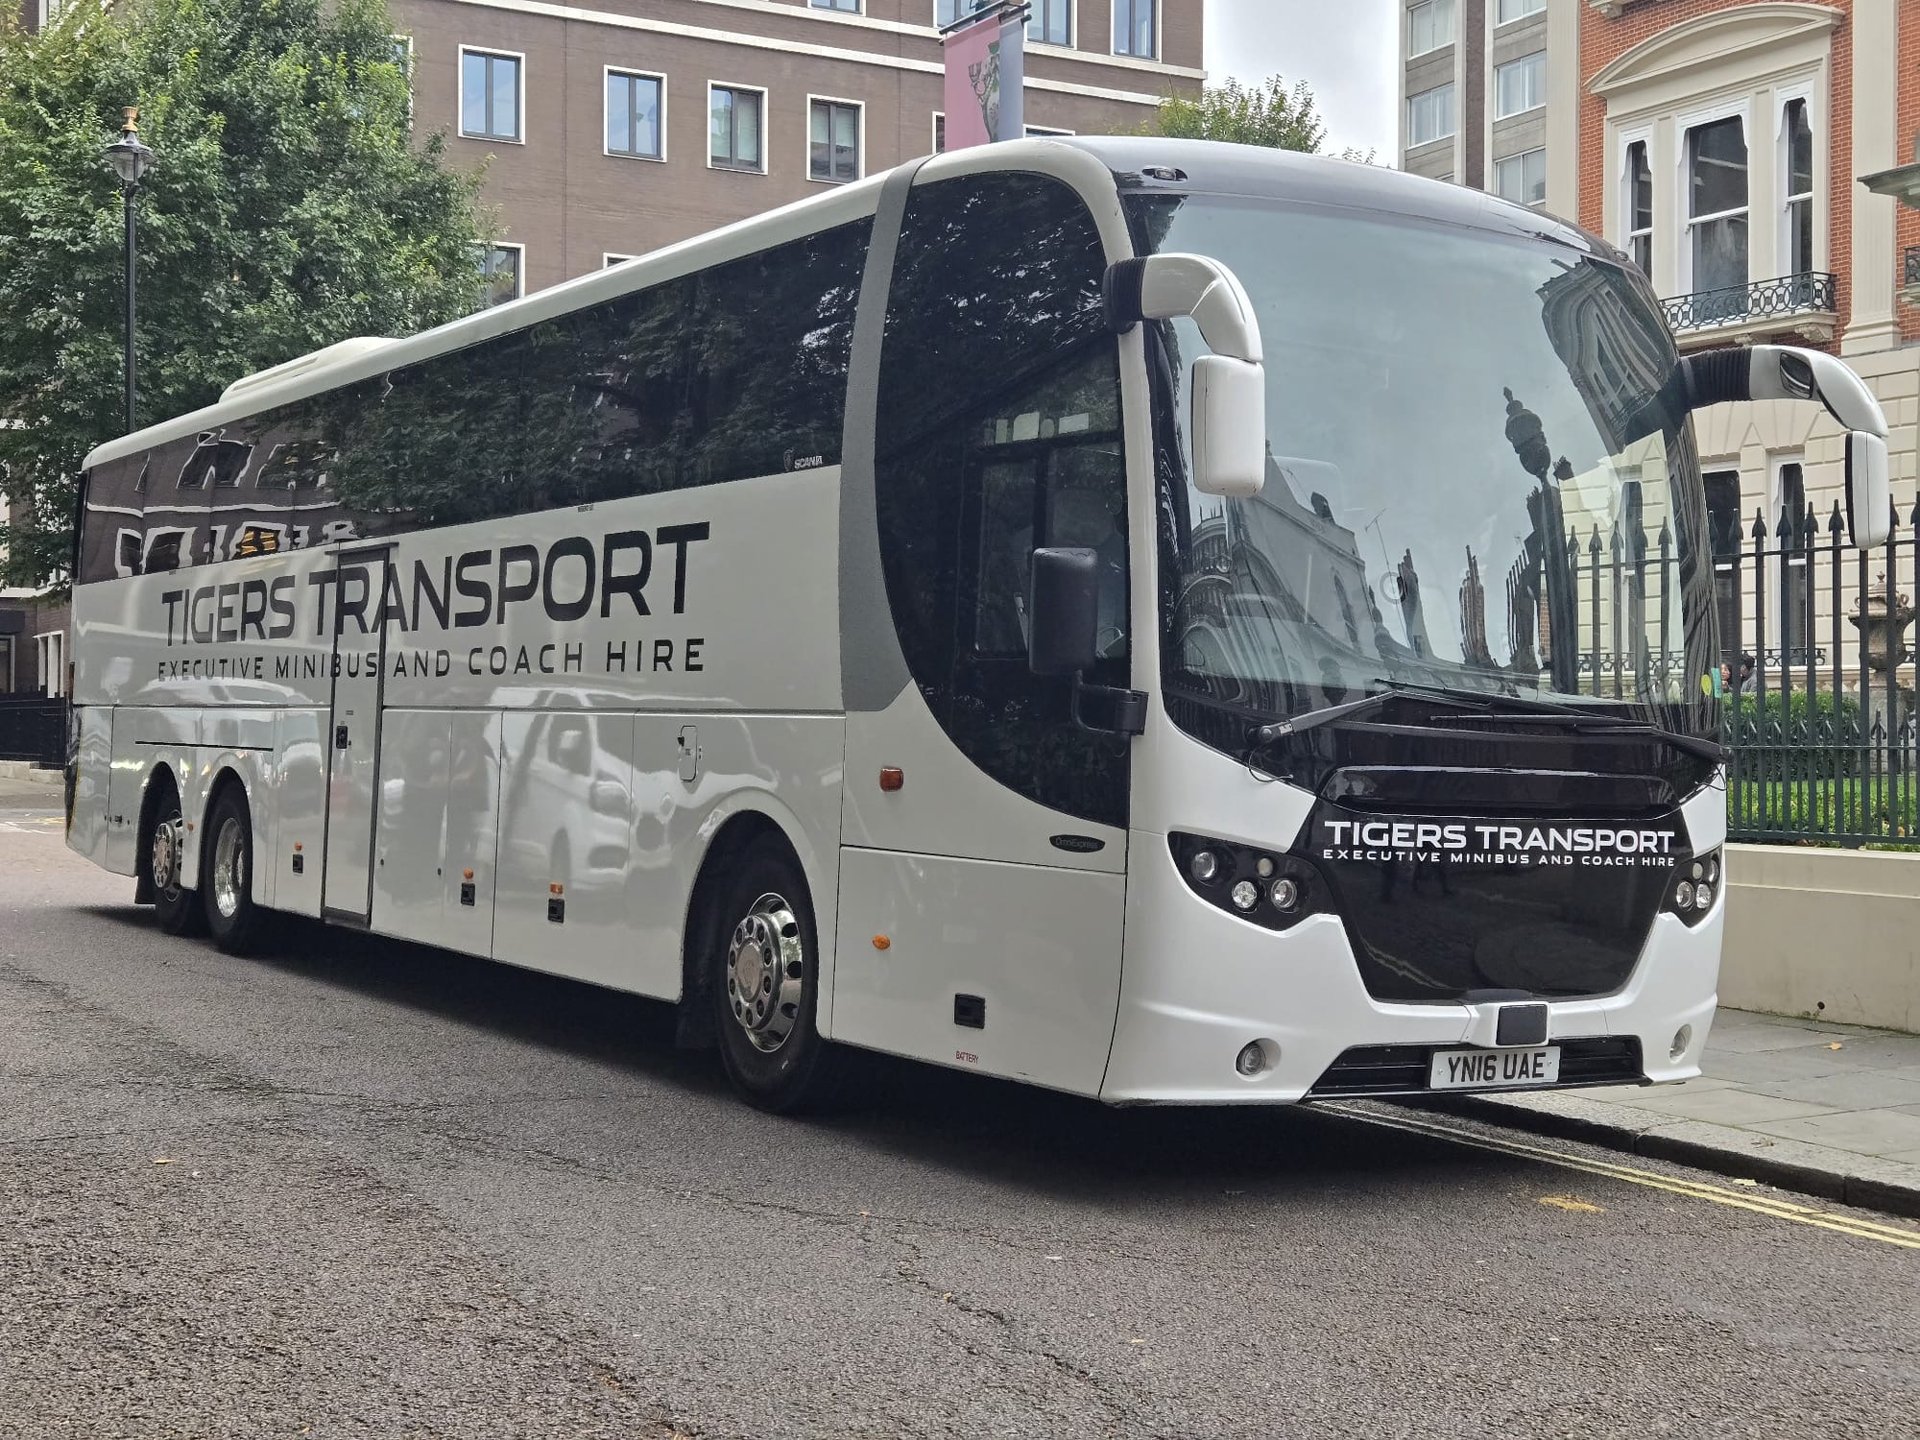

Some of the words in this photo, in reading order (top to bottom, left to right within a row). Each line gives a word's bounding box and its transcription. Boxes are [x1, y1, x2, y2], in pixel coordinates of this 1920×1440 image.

[162, 575, 296, 647] TIGERS
[308, 521, 710, 636] TRANSPORT
[158, 656, 264, 682] EXECUTIVE
[275, 652, 378, 679] MINIBUS
[393, 650, 450, 677] AND
[468, 642, 583, 675] COACH
[606, 638, 705, 672] HIRE
[1324, 821, 1467, 849] TIGERS
[1475, 826, 1675, 853] TRANSPORT
[1323, 849, 1441, 862] EXECUTIVE
[1450, 853, 1530, 864] MINIBUS
[1538, 855, 1574, 865] AND
[1581, 856, 1635, 866] COACH
[1642, 857, 1675, 867] HIRE
[956, 1051, 979, 1063] BATTERY
[1448, 1054, 1497, 1083] YN16
[1503, 1052, 1546, 1080] UAE
